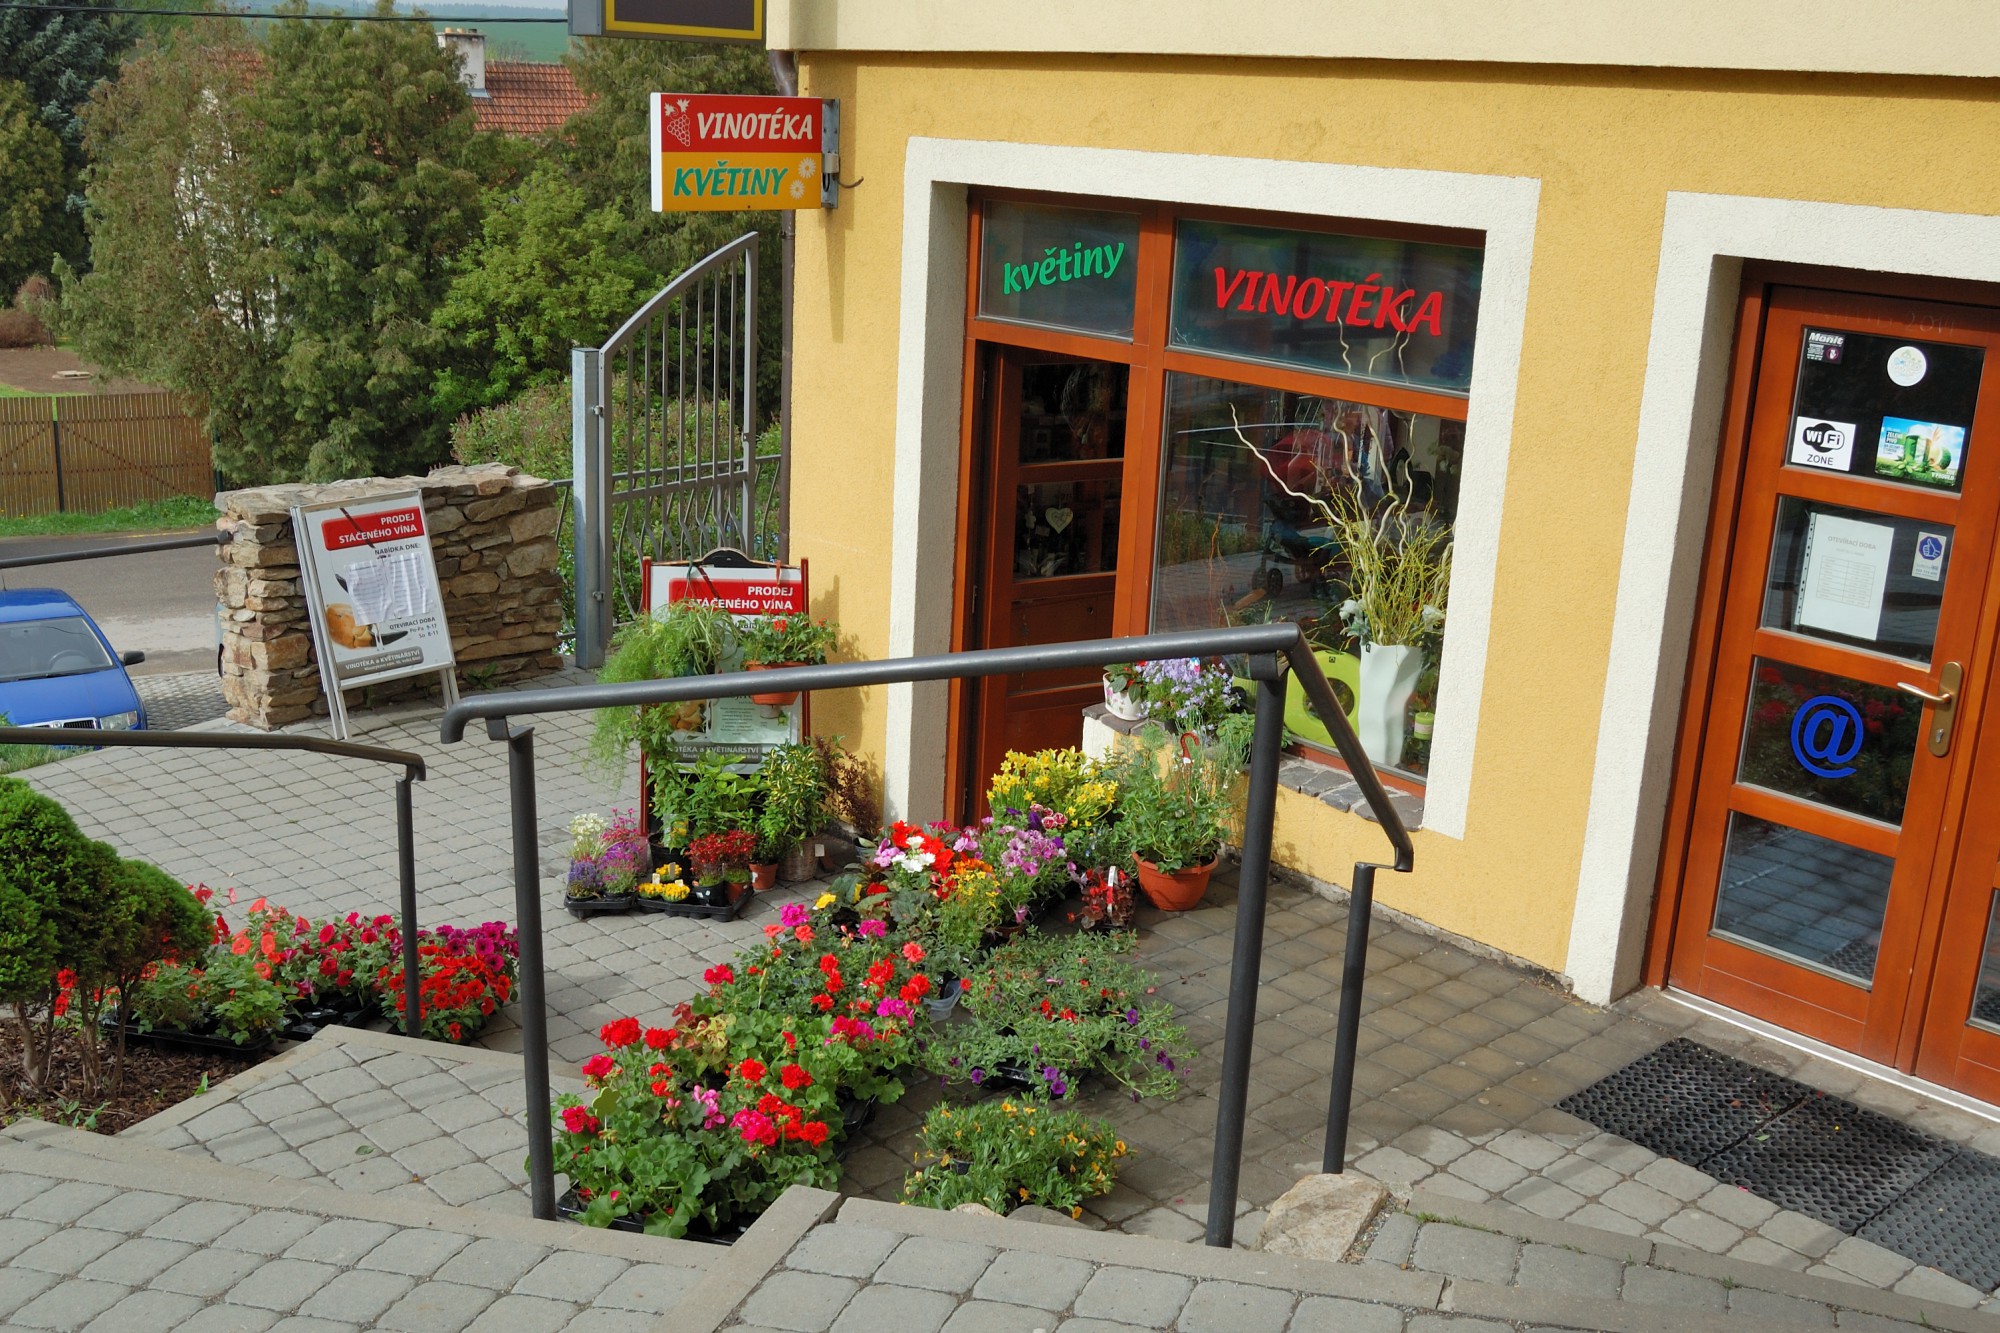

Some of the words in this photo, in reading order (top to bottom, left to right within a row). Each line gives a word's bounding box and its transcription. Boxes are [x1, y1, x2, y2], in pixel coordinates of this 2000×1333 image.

[697, 107, 813, 140] VINOTÉKA
[673, 160, 788, 196] KVĚTINY
[1003, 241, 1125, 295] květiny
[1214, 267, 1443, 336] VINOTÉKA
[1807, 453, 1834, 466] ZONE
[380, 513, 415, 525] PRODEJ
[339, 528, 392, 544] STÁČENÉHO
[394, 524, 417, 535] VÍNA
[374, 545, 404, 555] NABÍDKA
[747, 586, 793, 596] PRODEJ
[762, 598, 793, 610] VÍNA
[420, 616, 435, 624] DOBA
[345, 659, 375, 670] VINOTÉKA
